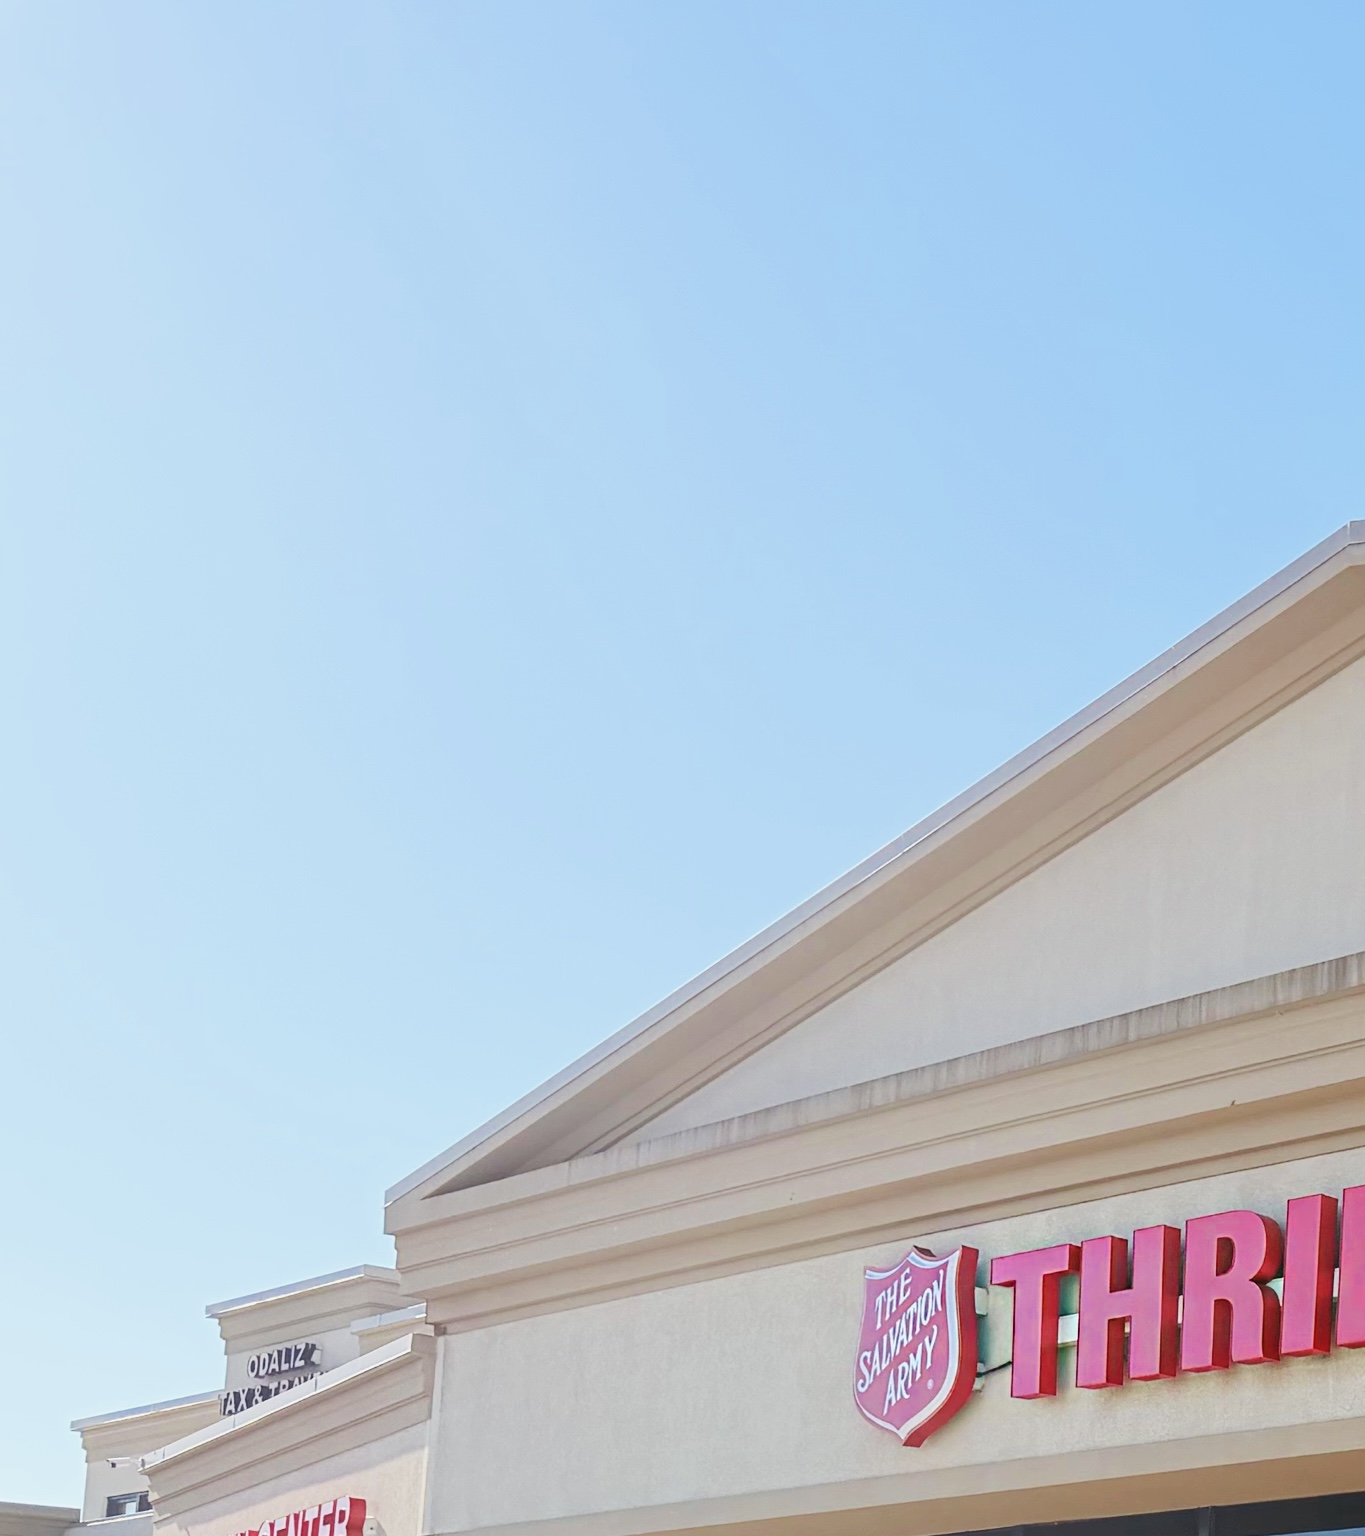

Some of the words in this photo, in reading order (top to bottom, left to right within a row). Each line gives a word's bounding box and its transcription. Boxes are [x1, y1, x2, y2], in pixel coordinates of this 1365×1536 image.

[857, 1268, 945, 1392] SALVATION
[874, 1266, 914, 1331] THE
[220, 1387, 248, 1416] TAX
[882, 1324, 938, 1417] ARMY
